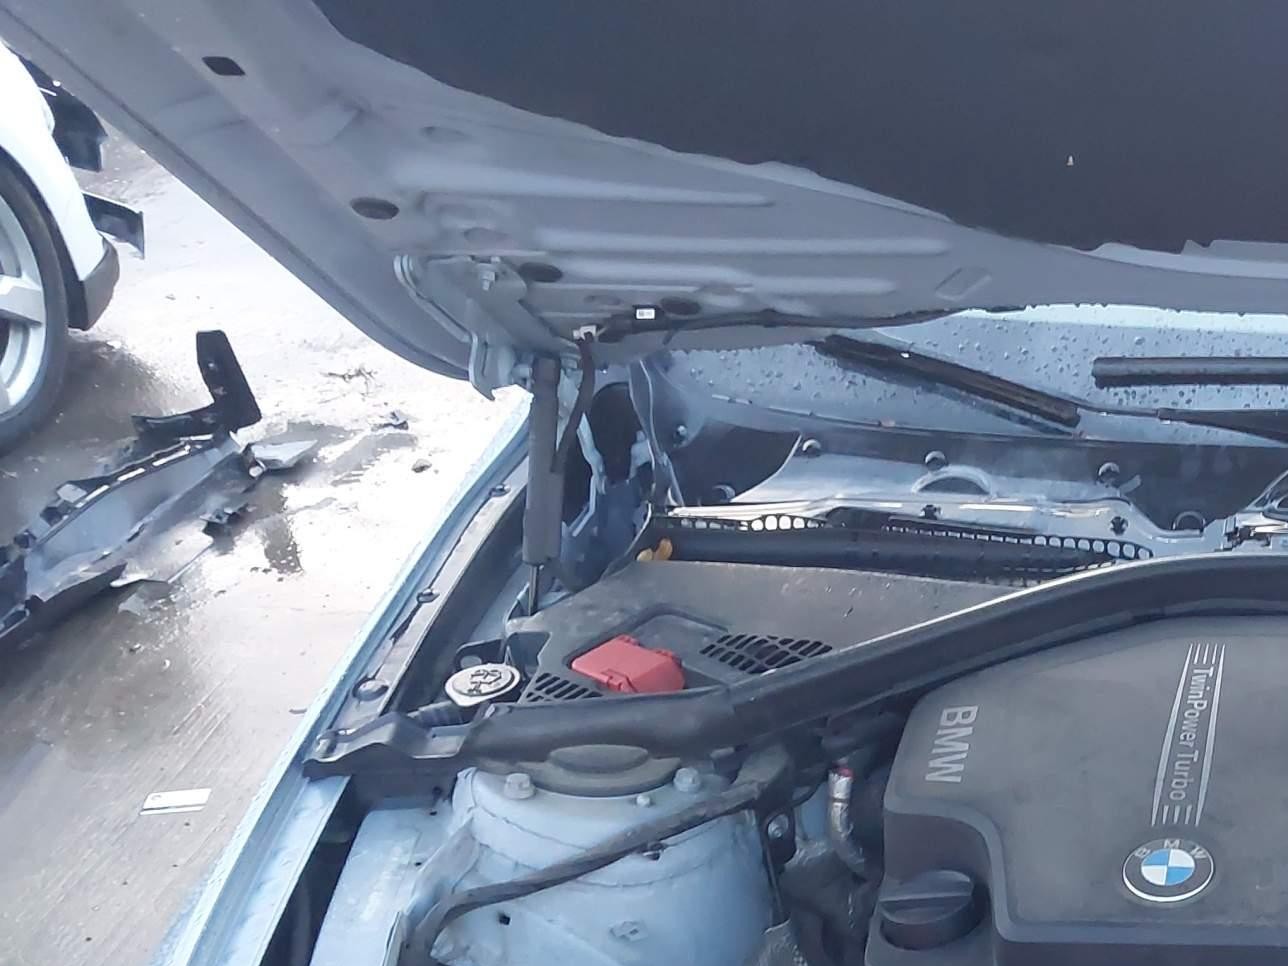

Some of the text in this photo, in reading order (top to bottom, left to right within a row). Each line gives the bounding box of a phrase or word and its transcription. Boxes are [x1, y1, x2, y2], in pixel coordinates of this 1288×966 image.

[925, 704, 979, 785] BMW
[1168, 666, 1214, 802] TwinPower Turbo
[1134, 838, 1209, 860] BMW
